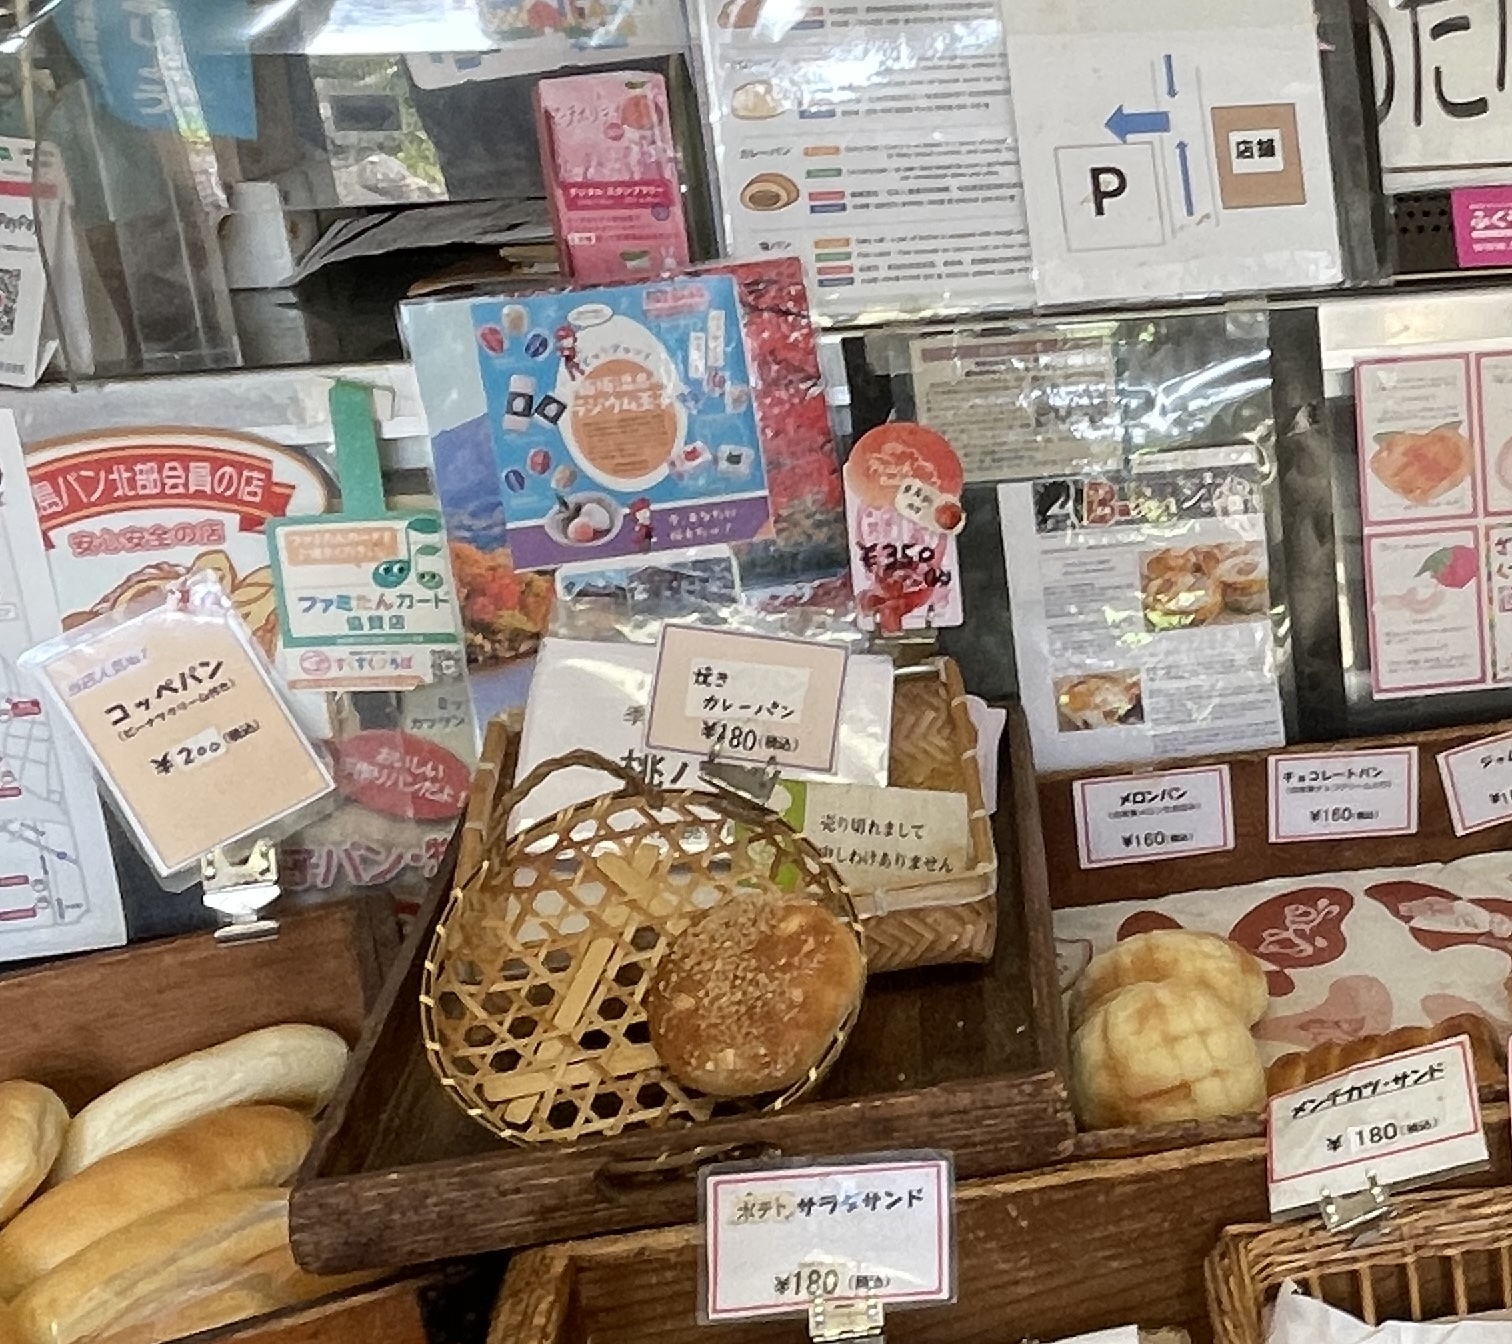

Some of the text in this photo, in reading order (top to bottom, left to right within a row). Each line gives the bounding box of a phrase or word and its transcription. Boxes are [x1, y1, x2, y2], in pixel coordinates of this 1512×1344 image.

[1235, 136, 1278, 161] 店舗
[1089, 167, 1127, 216] P
[70, 519, 225, 557] 安心安全の店
[298, 591, 451, 614] ファミたんカード
[692, 665, 730, 688] 焼き
[104, 660, 224, 726] コッペパン
[702, 694, 796, 720] カレーパン
[151, 740, 221, 775] ¥200
[1282, 765, 1384, 784] チョコレートパン
[1119, 786, 1189, 807] メロンパン
[1290, 1062, 1446, 1120] メンチカツ・サンド
[1325, 1122, 1399, 1153] ¥180
[735, 1186, 925, 1222] ポテトサラダサンド
[773, 1268, 840, 1297] ¥180
